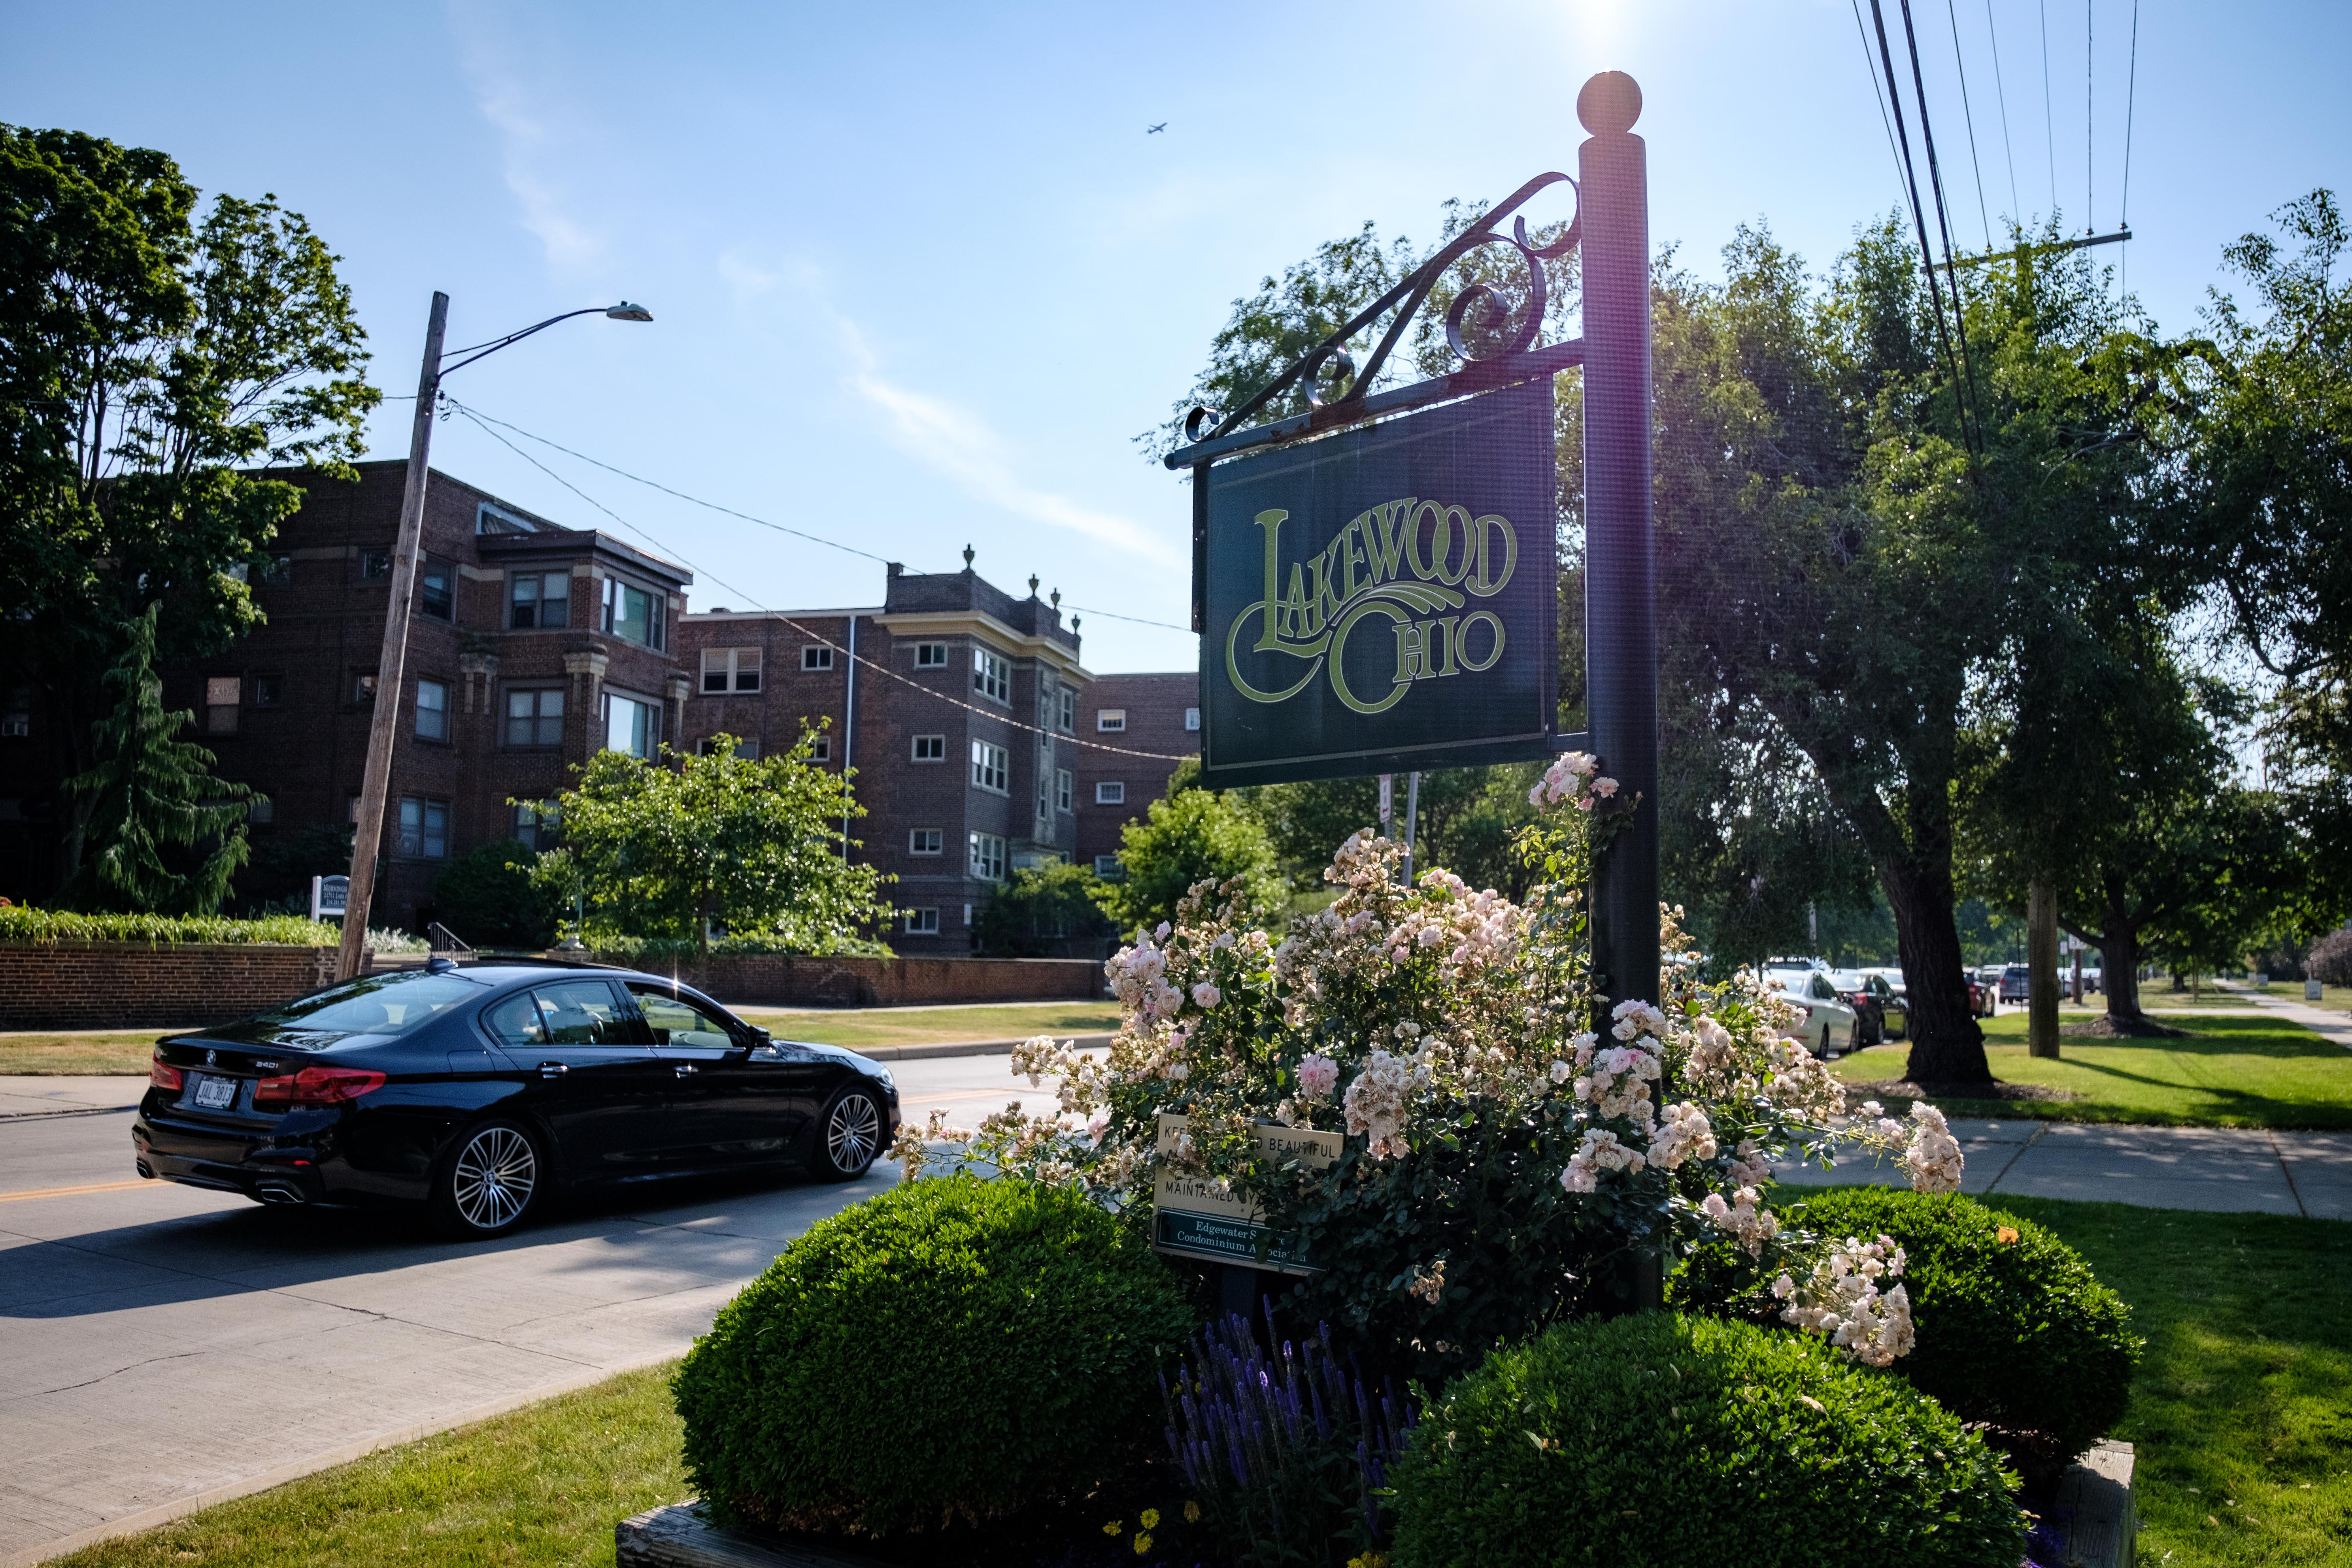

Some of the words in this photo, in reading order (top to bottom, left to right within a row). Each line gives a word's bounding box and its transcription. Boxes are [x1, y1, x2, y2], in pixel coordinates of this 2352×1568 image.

[1225, 497, 1518, 703] LAKEWOOD
[1329, 601, 1505, 714] OHIO
[199, 1083, 213, 1099] JAL
[213, 1085, 233, 1102] 3813
[1165, 1125, 1187, 1139] KEE
[1269, 1138, 1335, 1158] BEAUTIFUL
[1166, 1181, 1234, 1202] MAINTANED
[1177, 1230, 1245, 1251] Condominium
[1248, 1243, 1306, 1262] Aociain
[1196, 1221, 1248, 1239] Edgewater
